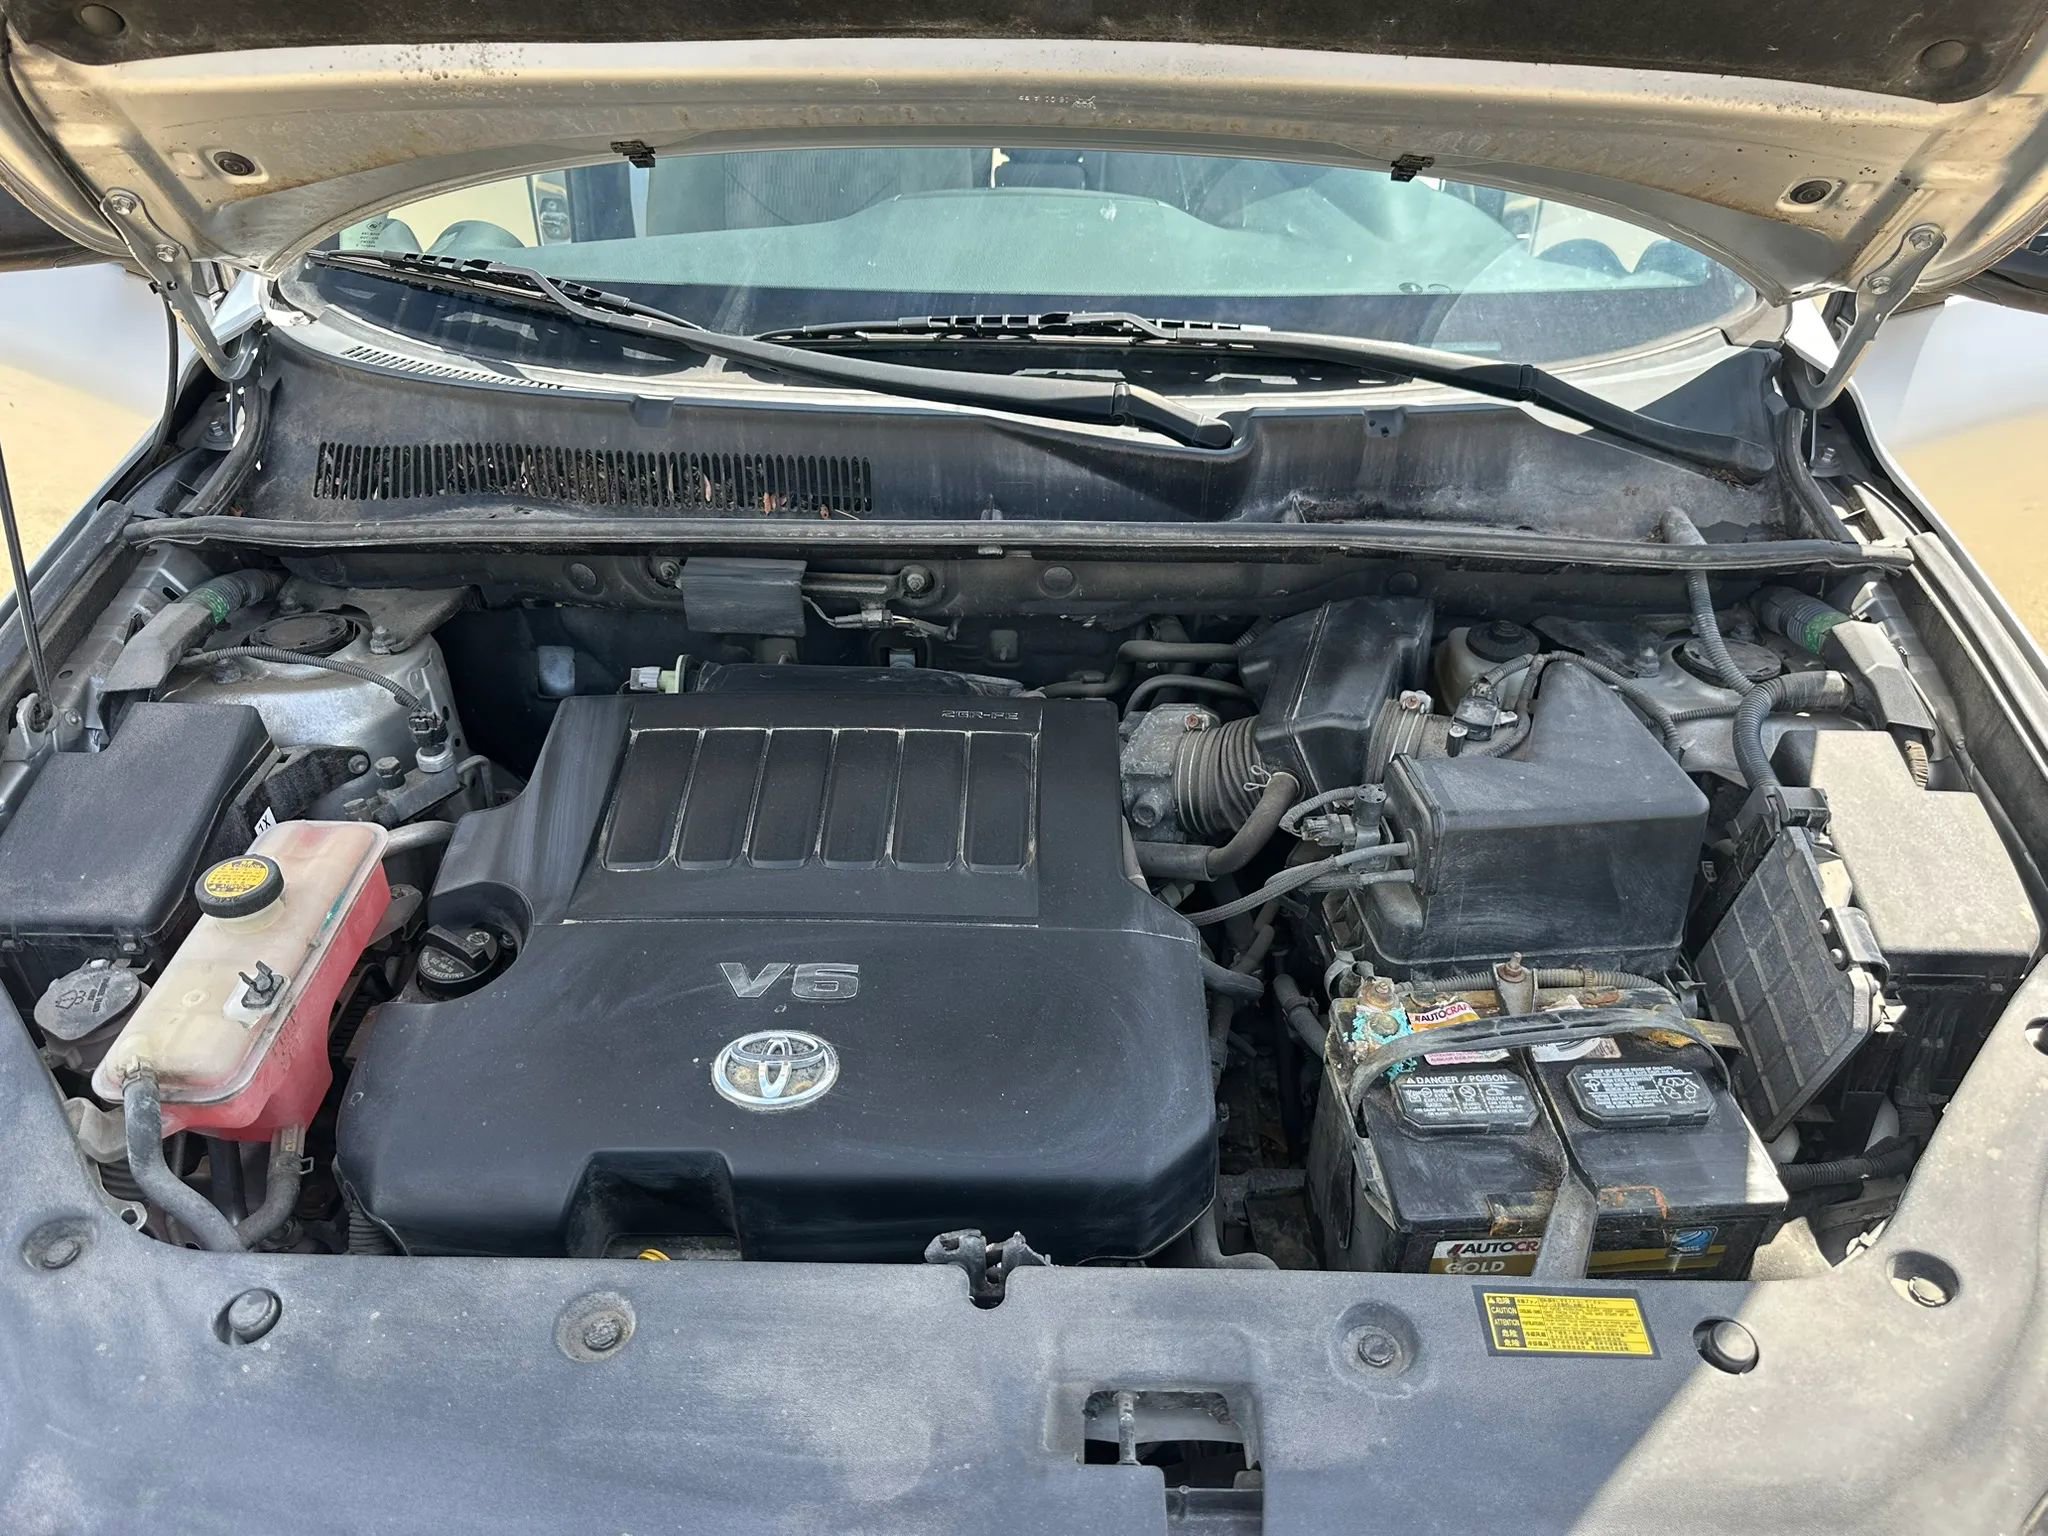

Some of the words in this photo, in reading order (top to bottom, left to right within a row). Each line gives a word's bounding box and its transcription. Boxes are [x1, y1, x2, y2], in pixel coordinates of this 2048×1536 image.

[941, 709, 1019, 720] 2GR-FE
[719, 962, 860, 999] V6
[1416, 1076, 1459, 1085] DANGER
[1469, 1074, 1508, 1082] POISON
[1461, 1241, 1539, 1254] AUTOCR
[1444, 1261, 1505, 1273] GOLD
[1491, 1306, 1518, 1314] CAUTION
[1494, 1318, 1520, 1326] ATTENTION
